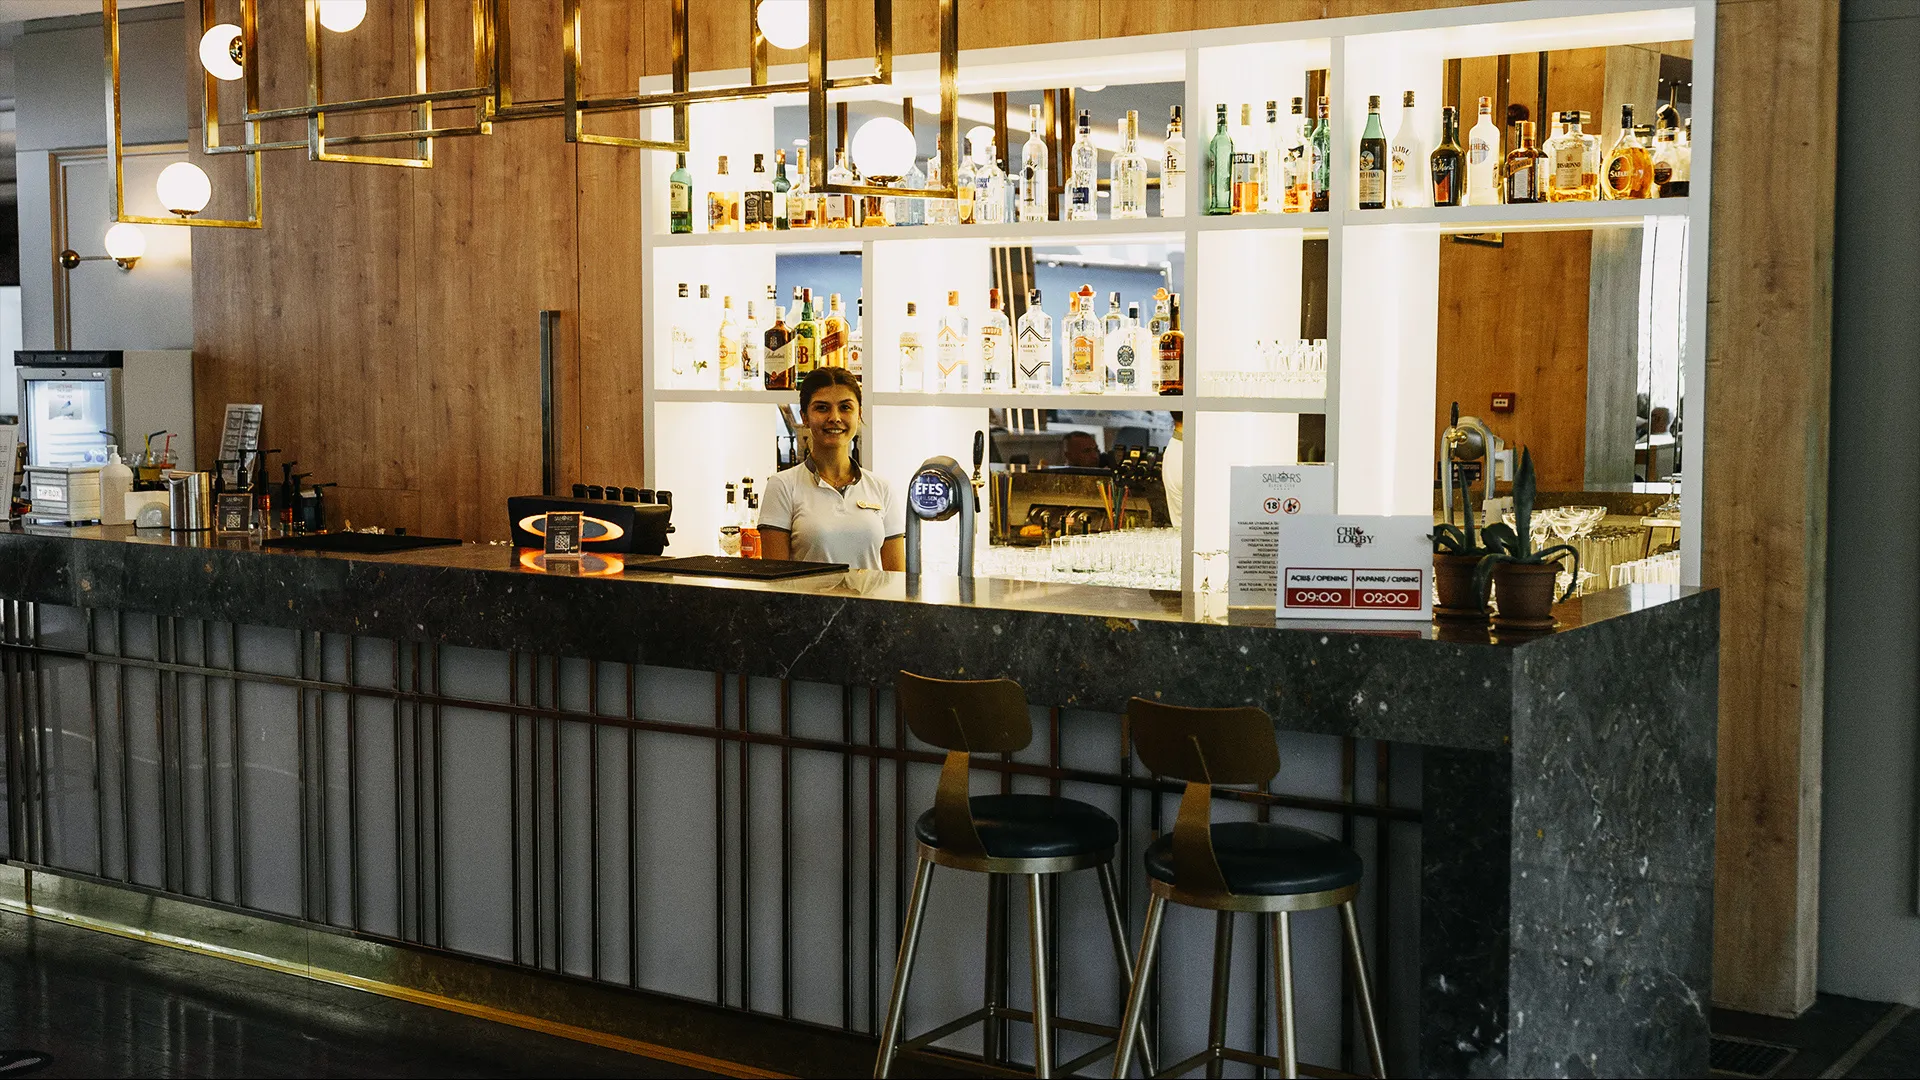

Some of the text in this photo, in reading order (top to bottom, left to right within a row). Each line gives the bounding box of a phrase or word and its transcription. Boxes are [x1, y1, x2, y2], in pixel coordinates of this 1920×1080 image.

[915, 482, 944, 496] EFES
[1266, 502, 1278, 510] 18
[1337, 535, 1375, 544] LOBBY
[1295, 591, 1342, 603] 09:00
[1363, 592, 1409, 604] 02:00
